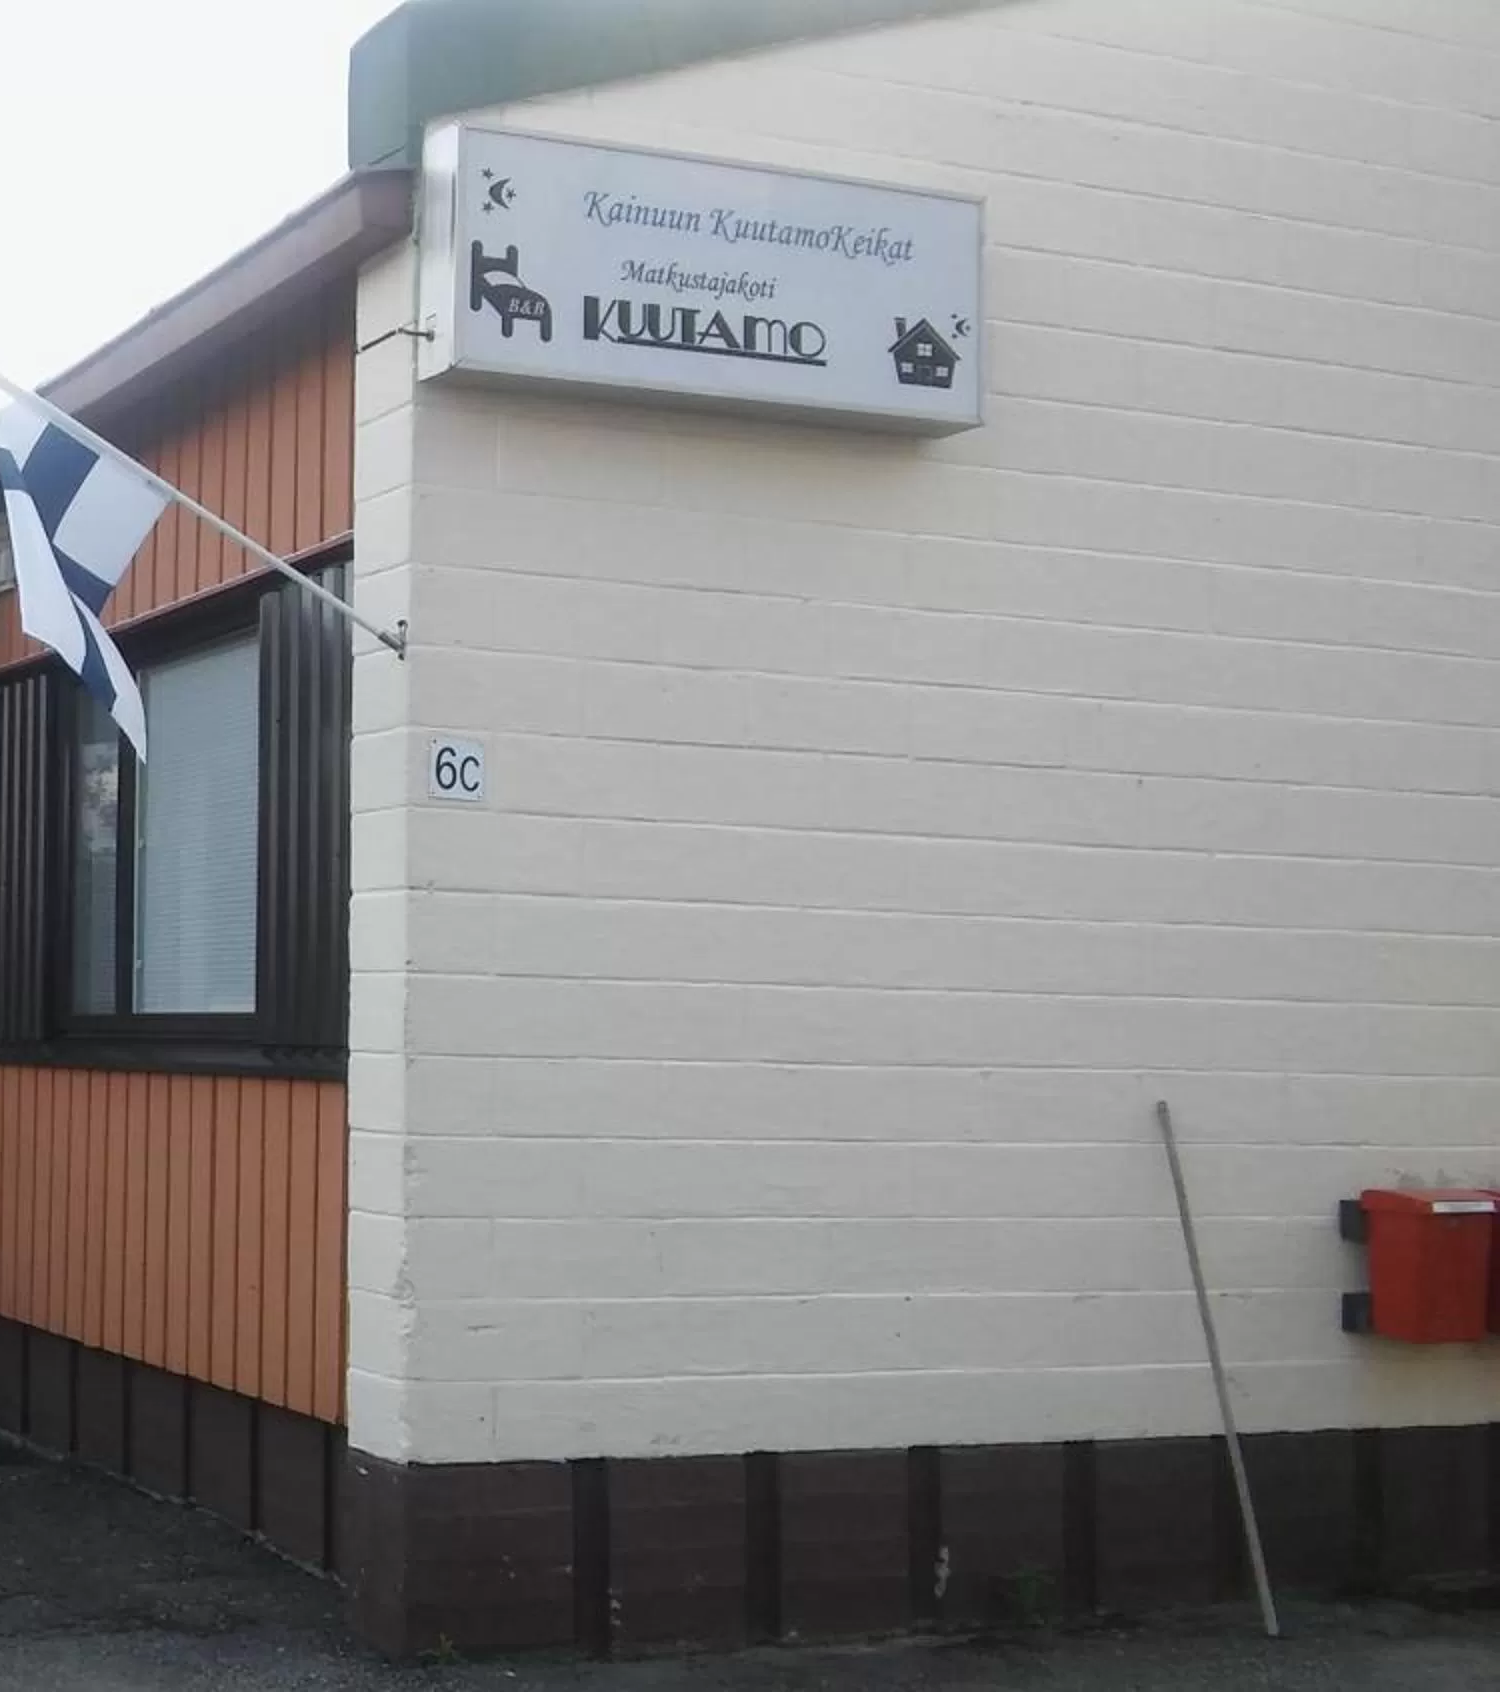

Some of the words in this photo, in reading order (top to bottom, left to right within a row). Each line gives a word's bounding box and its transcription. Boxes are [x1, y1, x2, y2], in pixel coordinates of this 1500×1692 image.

[584, 191, 701, 233] Kainuun
[707, 206, 915, 266] KuutamoKeikat
[620, 259, 778, 301] Matkustajakoti
